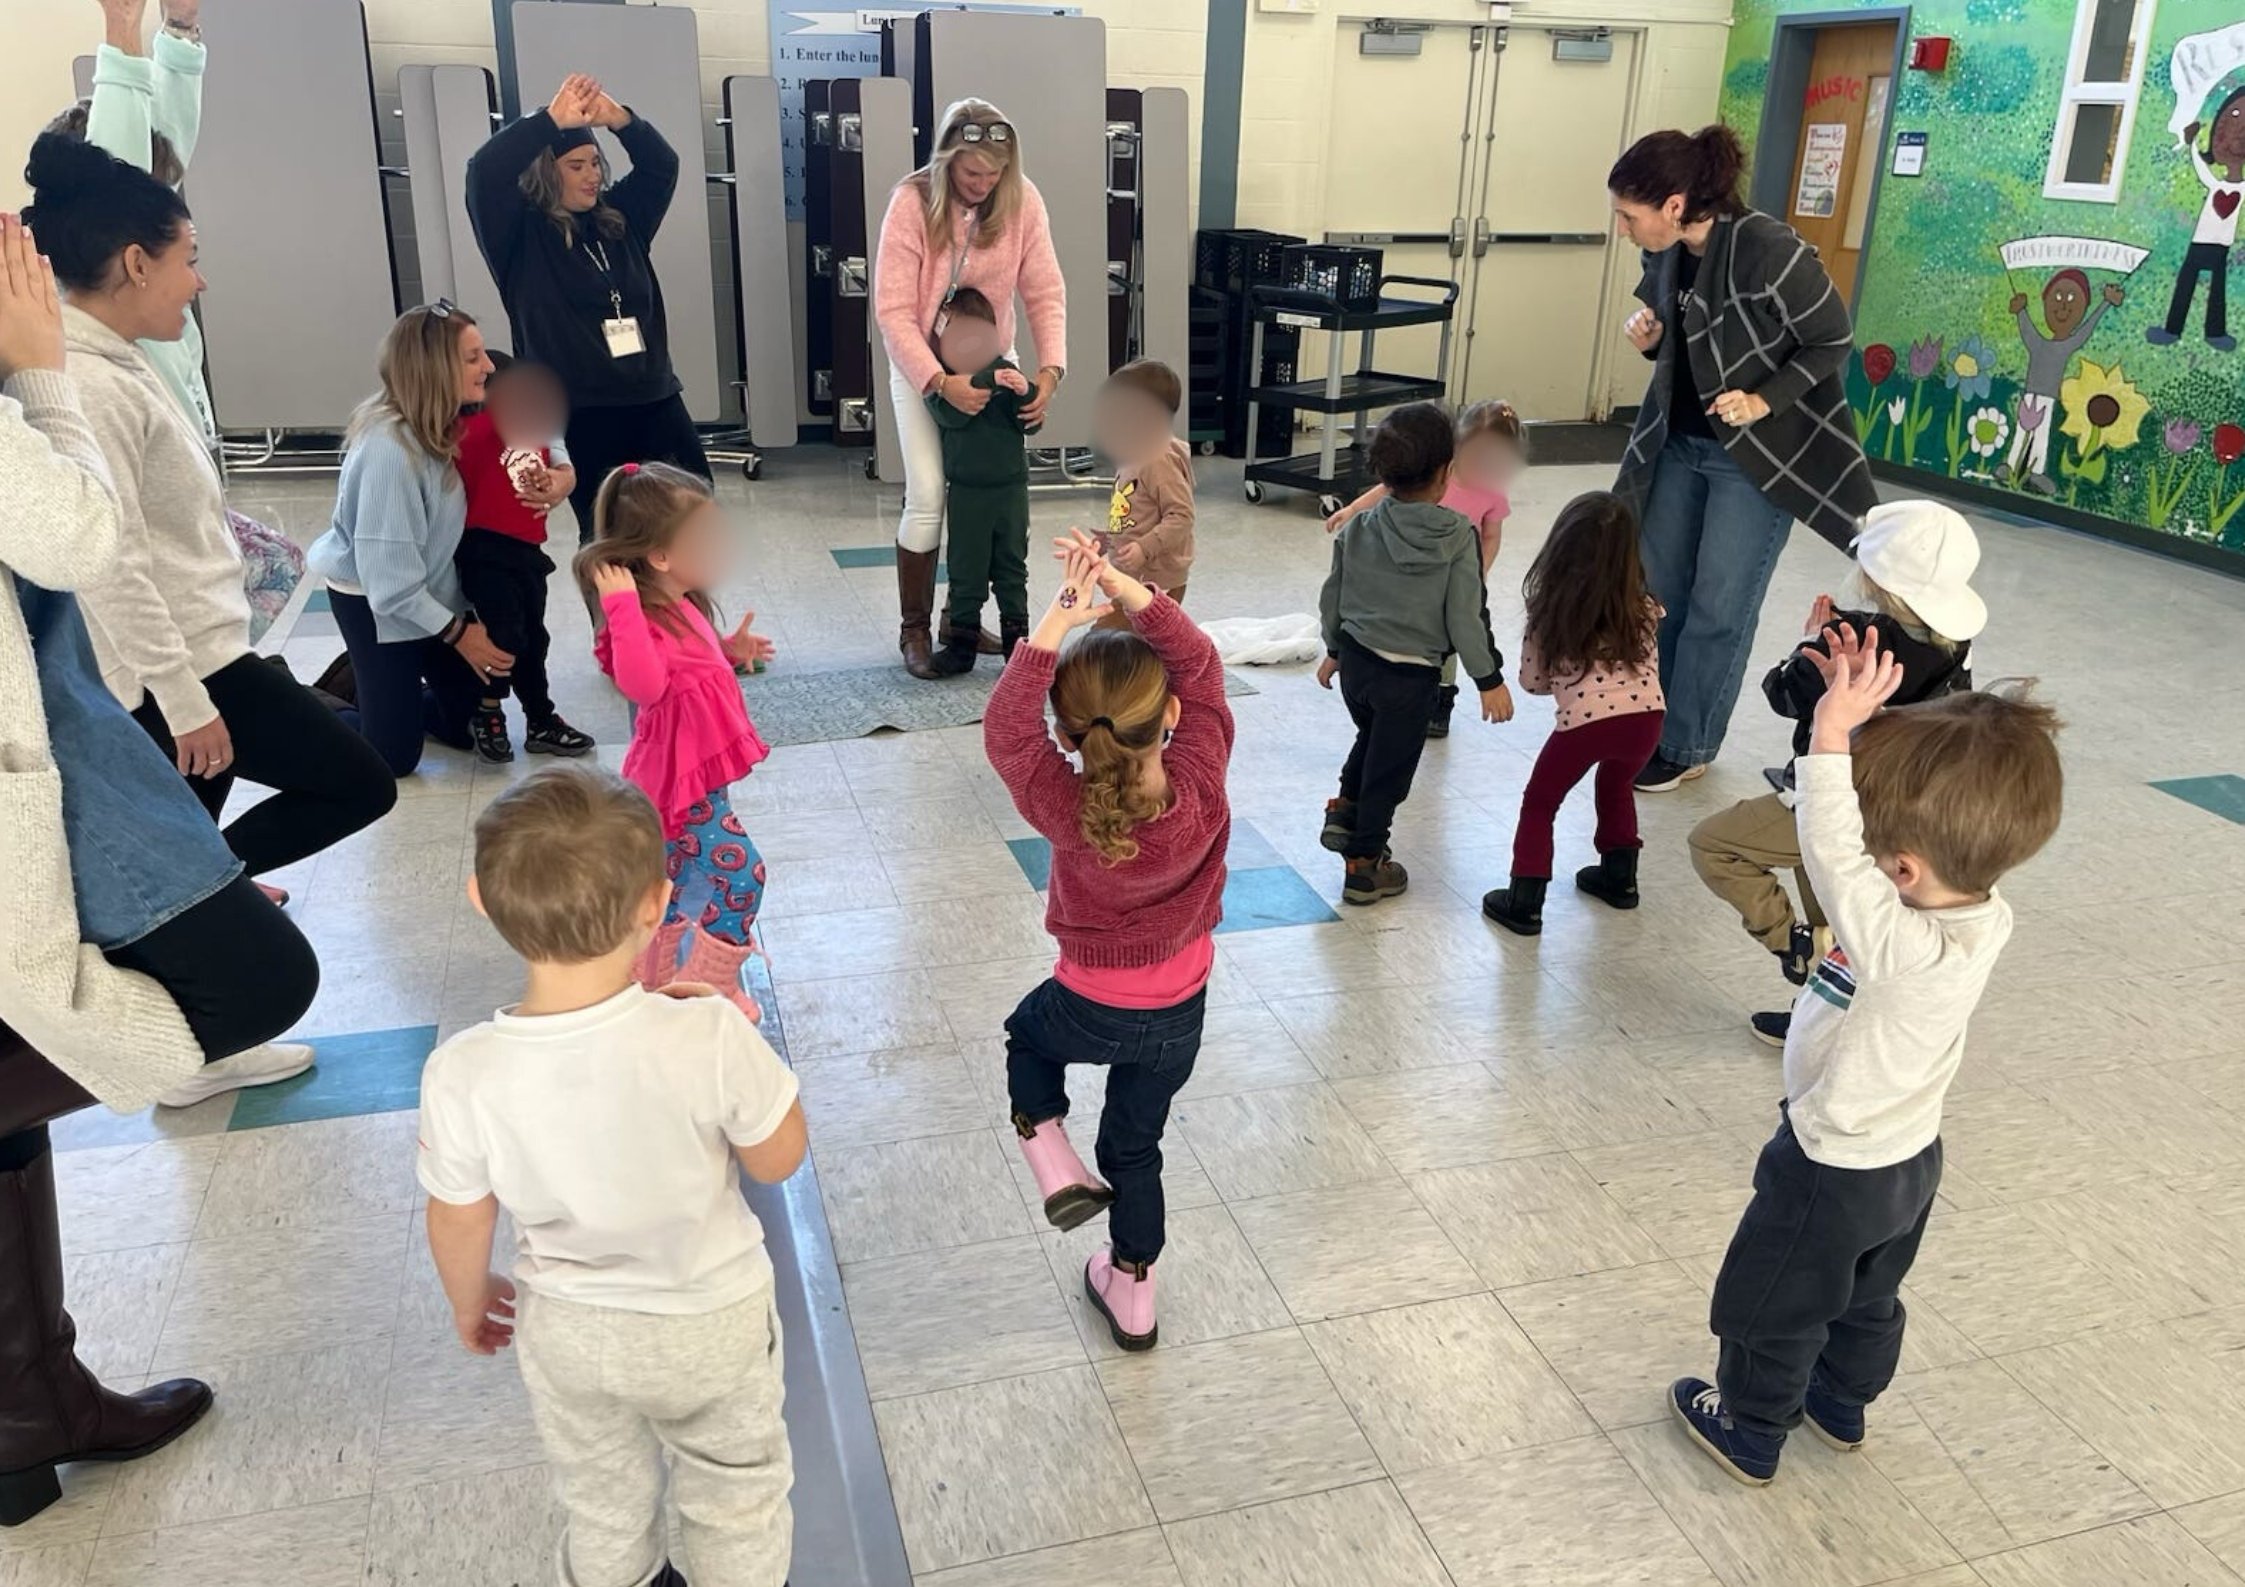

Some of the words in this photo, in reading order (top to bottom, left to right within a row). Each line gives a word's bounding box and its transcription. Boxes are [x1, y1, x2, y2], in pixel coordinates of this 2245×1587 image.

[780, 47, 790, 60] 1.
[797, 47, 832, 62] Enter
[836, 49, 857, 63] the
[781, 77, 792, 91] 2.
[1804, 75, 1863, 110] MUSIC
[781, 107, 793, 120] 3.
[783, 137, 794, 149] 4.
[784, 166, 795, 178] 5.
